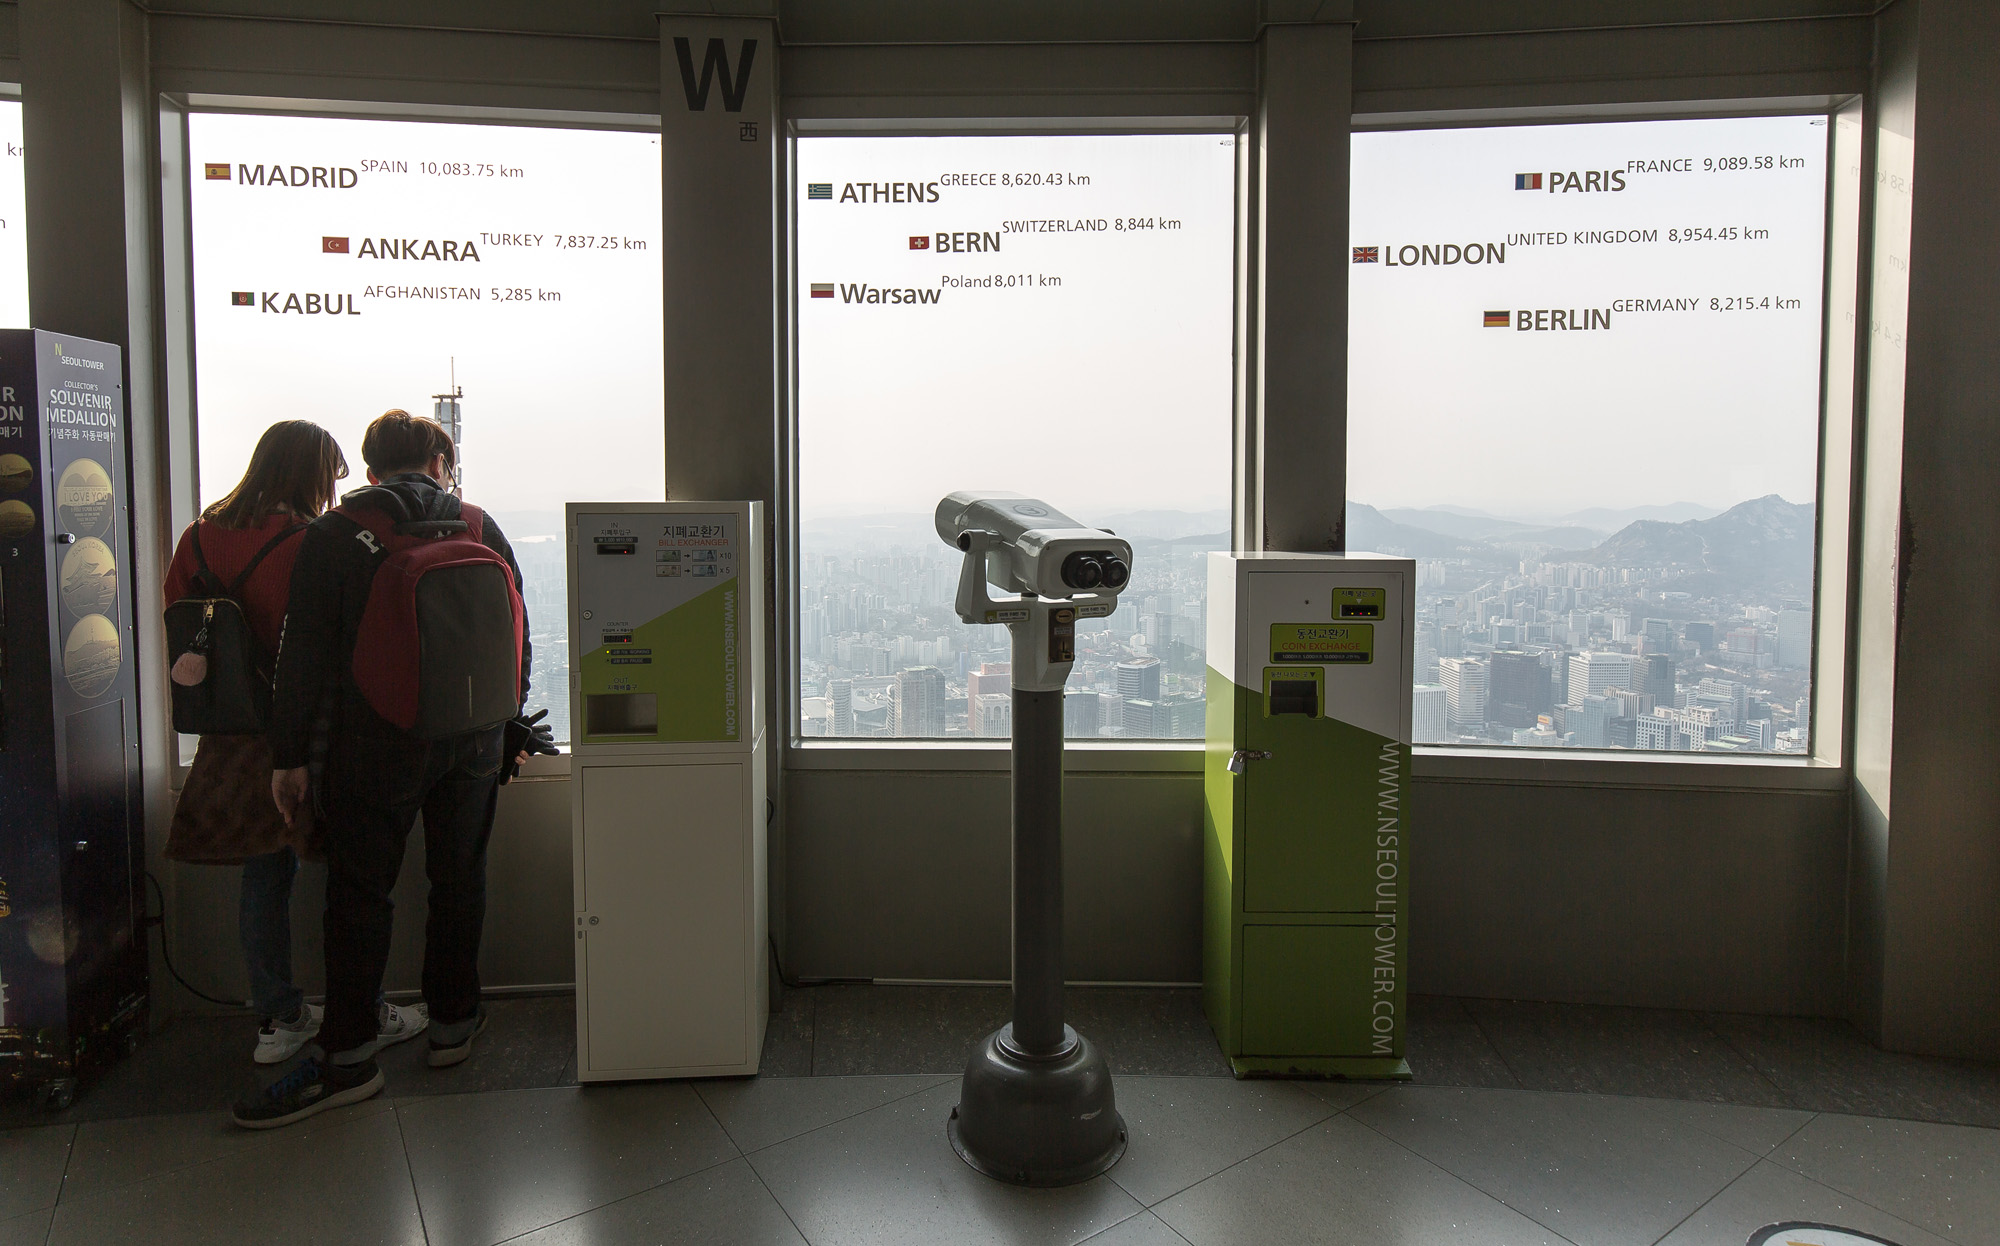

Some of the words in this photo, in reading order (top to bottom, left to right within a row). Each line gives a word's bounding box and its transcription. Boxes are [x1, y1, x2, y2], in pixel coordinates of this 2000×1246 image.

[673, 37, 757, 112] W
[739, 121, 757, 142] 西
[239, 163, 358, 189] MADRID
[361, 159, 408, 174] SPAIN
[419, 161, 495, 178] 10,083.75
[500, 164, 524, 178] km
[1549, 169, 1625, 194] PARIS
[1627, 158, 1693, 174] FRANCE
[1703, 155, 1774, 172] 9,089.58
[1779, 154, 1805, 169] km
[839, 181, 940, 204] ATHENS
[940, 173, 997, 187] GREECE
[1001, 172, 1063, 189] 8,620.43
[1068, 172, 1091, 186] km
[357, 237, 481, 263] ANKARA
[480, 232, 544, 247] TURKEY
[554, 234, 619, 251] 7,837.25
[622, 236, 648, 251] km
[935, 231, 1001, 254] BERN
[1002, 218, 1108, 234] SWITZERLAND
[1114, 217, 1155, 233] 8,844
[1159, 216, 1181, 230] km
[1385, 242, 1506, 267] LONDON
[1507, 232, 1568, 247] UNITED
[1573, 229, 1658, 245] KINGDOM
[1668, 227, 1738, 243] 8,954.45
[1743, 225, 1769, 240] km
[261, 291, 361, 316] KABUL
[363, 285, 481, 301] AFGHANISTAN
[491, 288, 533, 303] 5,285
[538, 288, 561, 302] km
[839, 283, 941, 305] Warsaw
[941, 274, 992, 289] Poland
[994, 274, 1033, 290] 8,011
[1039, 273, 1062, 287] km
[1516, 308, 1611, 332] BERLIN
[1612, 297, 1700, 313] GERMANY
[1709, 296, 1770, 313] 8,215.4
[1775, 295, 1801, 310] km
[54, 343, 62, 356] N
[50, 388, 112, 410] SOUVENIR
[64, 380, 99, 392] COLLECTOR'S
[46, 407, 117, 428] MEDALLION
[69, 492, 90, 502] LOVE
[355, 529, 379, 554] P
[658, 539, 676, 547] BILL
[677, 539, 729, 547] EXCHANGER
[663, 525, 724, 538] 지폐교환기
[12, 547, 19, 557] 3
[1281, 642, 1306, 650] COIN
[1309, 642, 1361, 650] EXCHANGE
[1297, 628, 1349, 640] 동전교환기
[724, 590, 735, 736] WWW.NSEOULTOWER.COM
[1372, 741, 1400, 1054] WWW.NSEOULTOWER.COM
